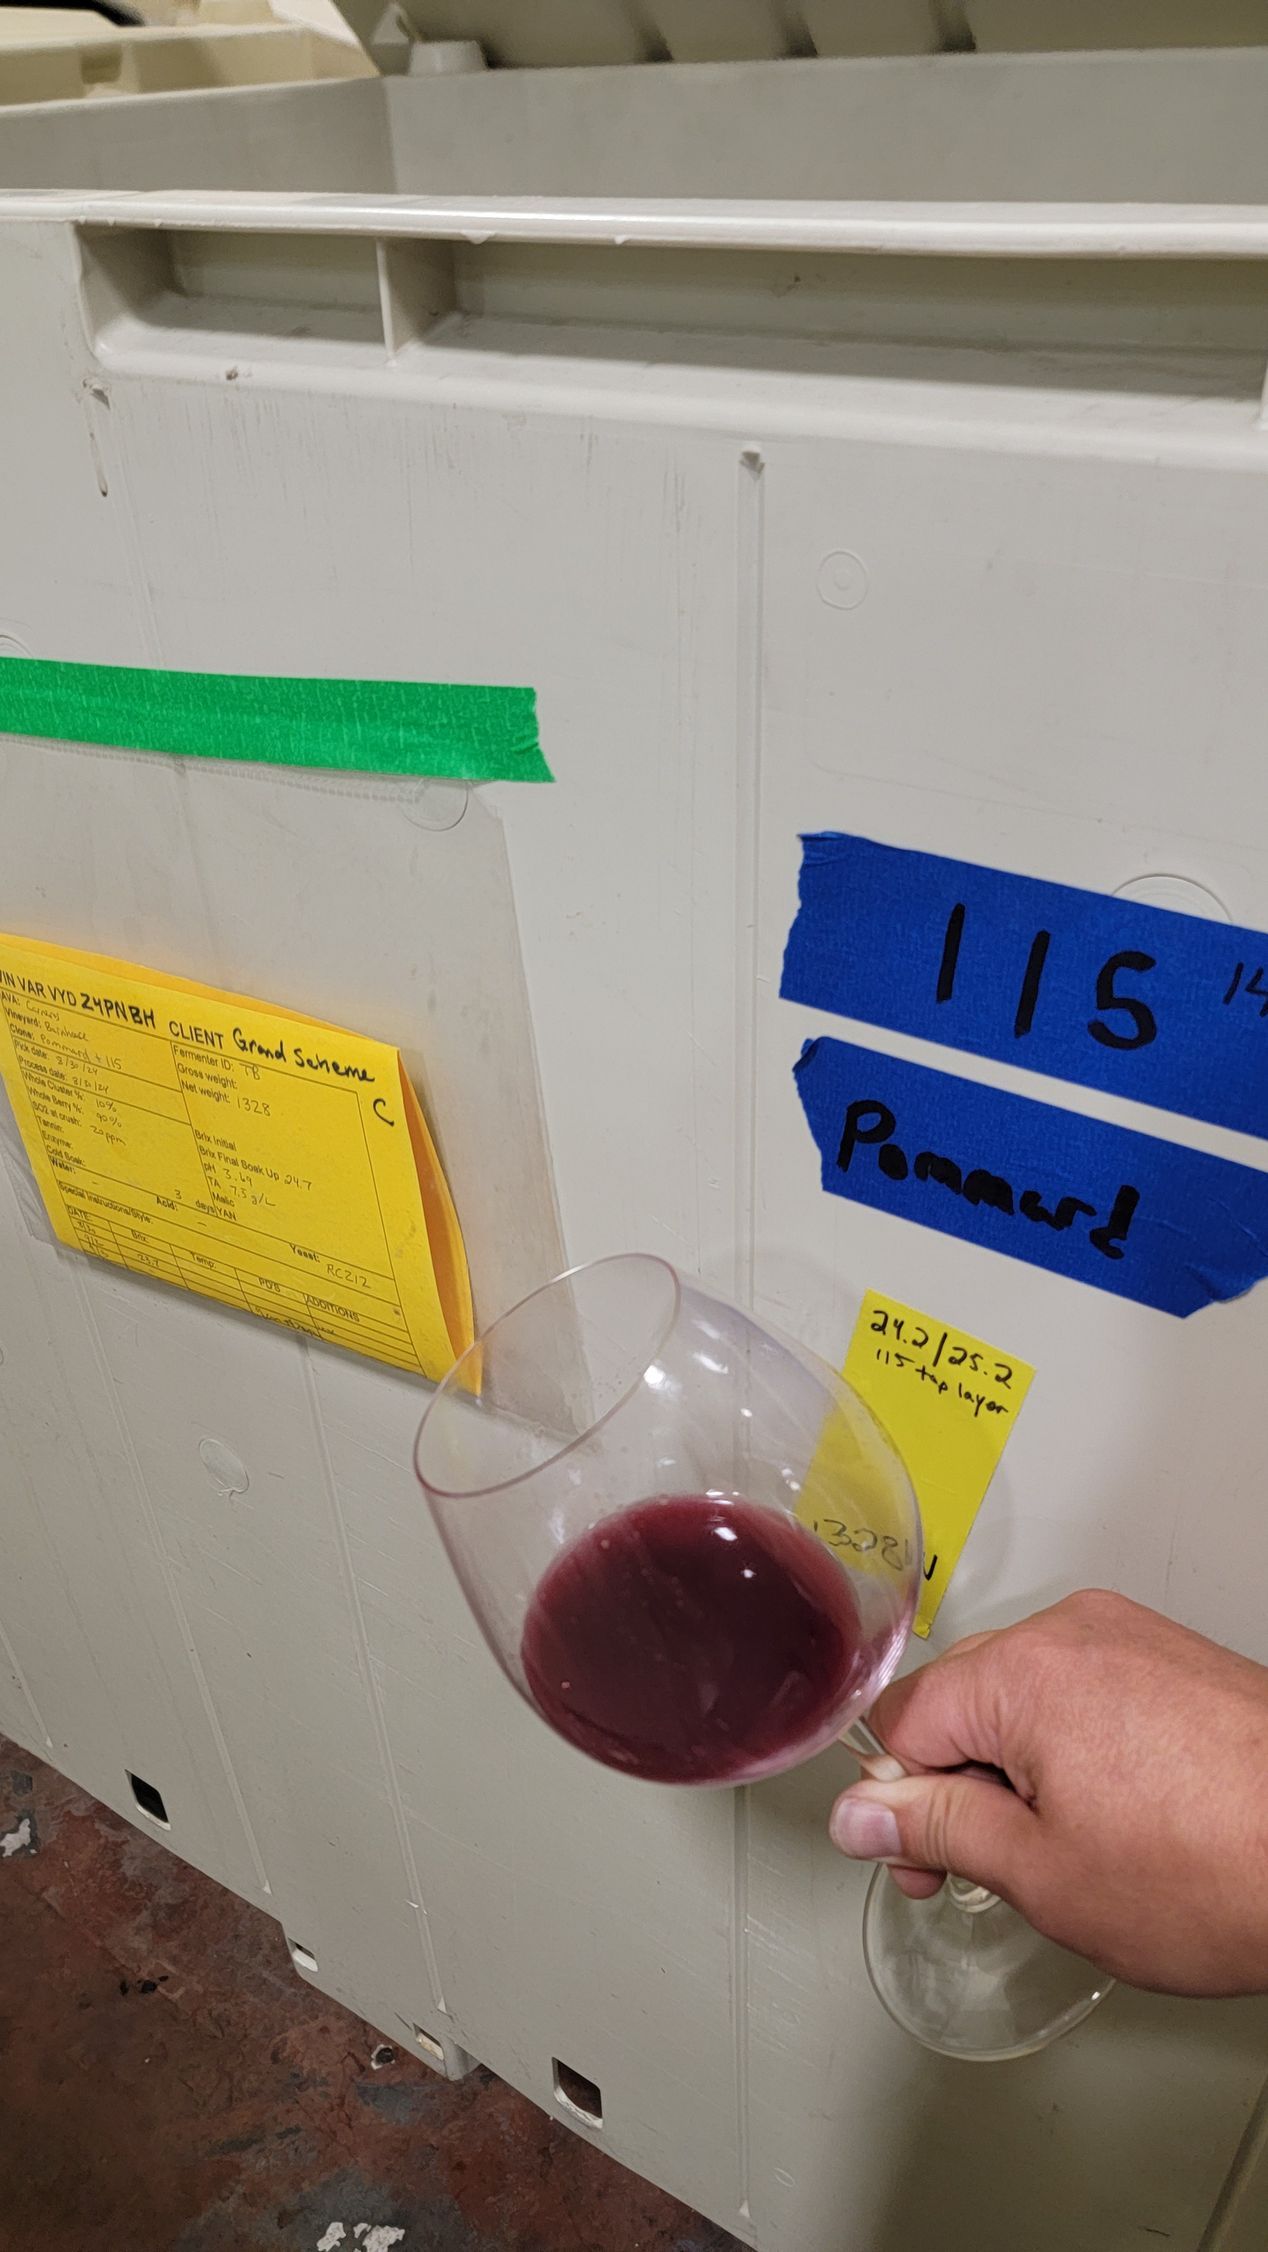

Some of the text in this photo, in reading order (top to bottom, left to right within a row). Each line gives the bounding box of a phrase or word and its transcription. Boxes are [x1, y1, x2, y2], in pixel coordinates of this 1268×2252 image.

[936, 902, 1157, 1050] 115
[17, 975, 47, 999] VAR
[47, 985, 77, 1007] VYD
[169, 1020, 224, 1050] CLIENT
[233, 1027, 287, 1063] Grand
[106, 1055, 122, 1070] 115
[173, 1044, 219, 1067] Fermenter
[177, 1062, 204, 1079] Gross
[181, 1079, 198, 1094] Net
[237, 1096, 271, 1117] 1328
[194, 1128, 212, 1143] Brix
[200, 1145, 217, 1160] Brix
[217, 1150, 240, 1168] Final
[207, 1175, 222, 1190] TA
[836, 1099, 1141, 1260] Pommard
[326, 1264, 371, 1289] RC212
[870, 1309, 1014, 1390] 24.2/25.2
[876, 1348, 916, 1368] 115
